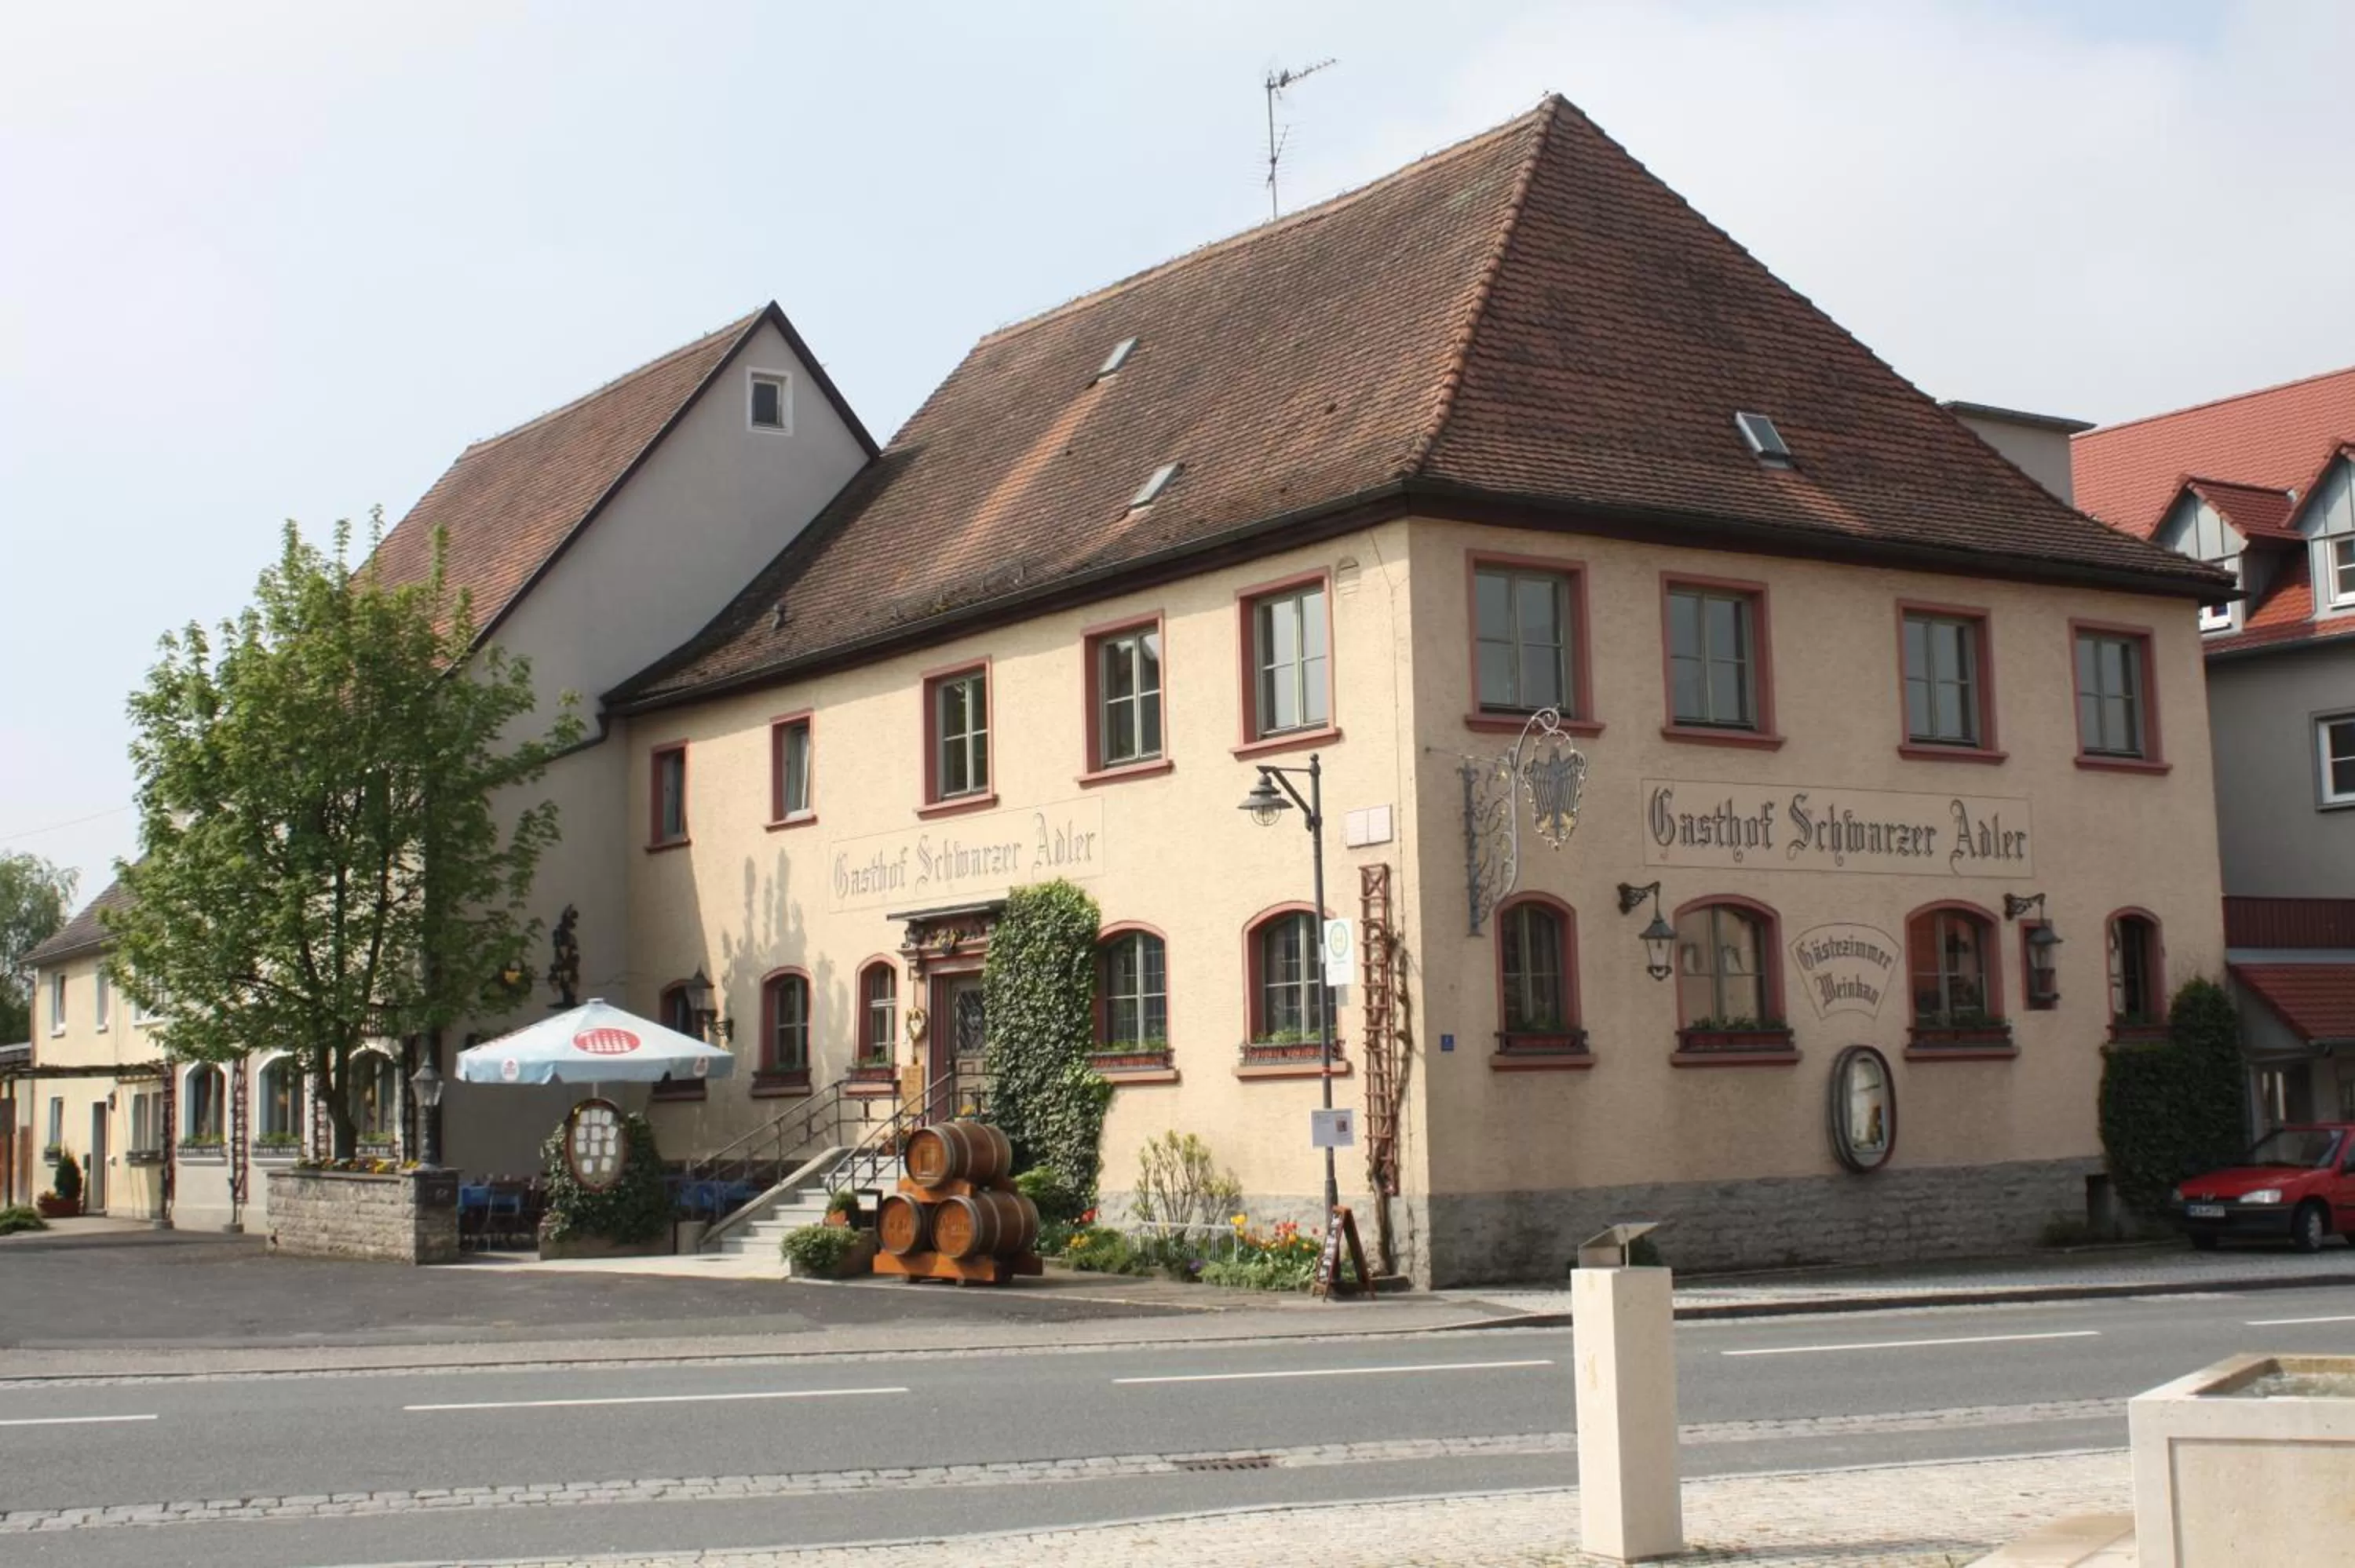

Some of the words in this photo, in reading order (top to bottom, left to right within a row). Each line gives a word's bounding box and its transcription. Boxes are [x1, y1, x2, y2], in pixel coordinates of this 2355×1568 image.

[834, 846, 908, 899] Gasthof
[915, 834, 1022, 894] Schwarzer
[1031, 811, 1097, 880] Adler
[1649, 786, 1776, 863] Gasthof
[1786, 793, 1938, 867] Schwarzer
[1949, 799, 2027, 877] Adler
[1795, 934, 1893, 971] Gästezimmer
